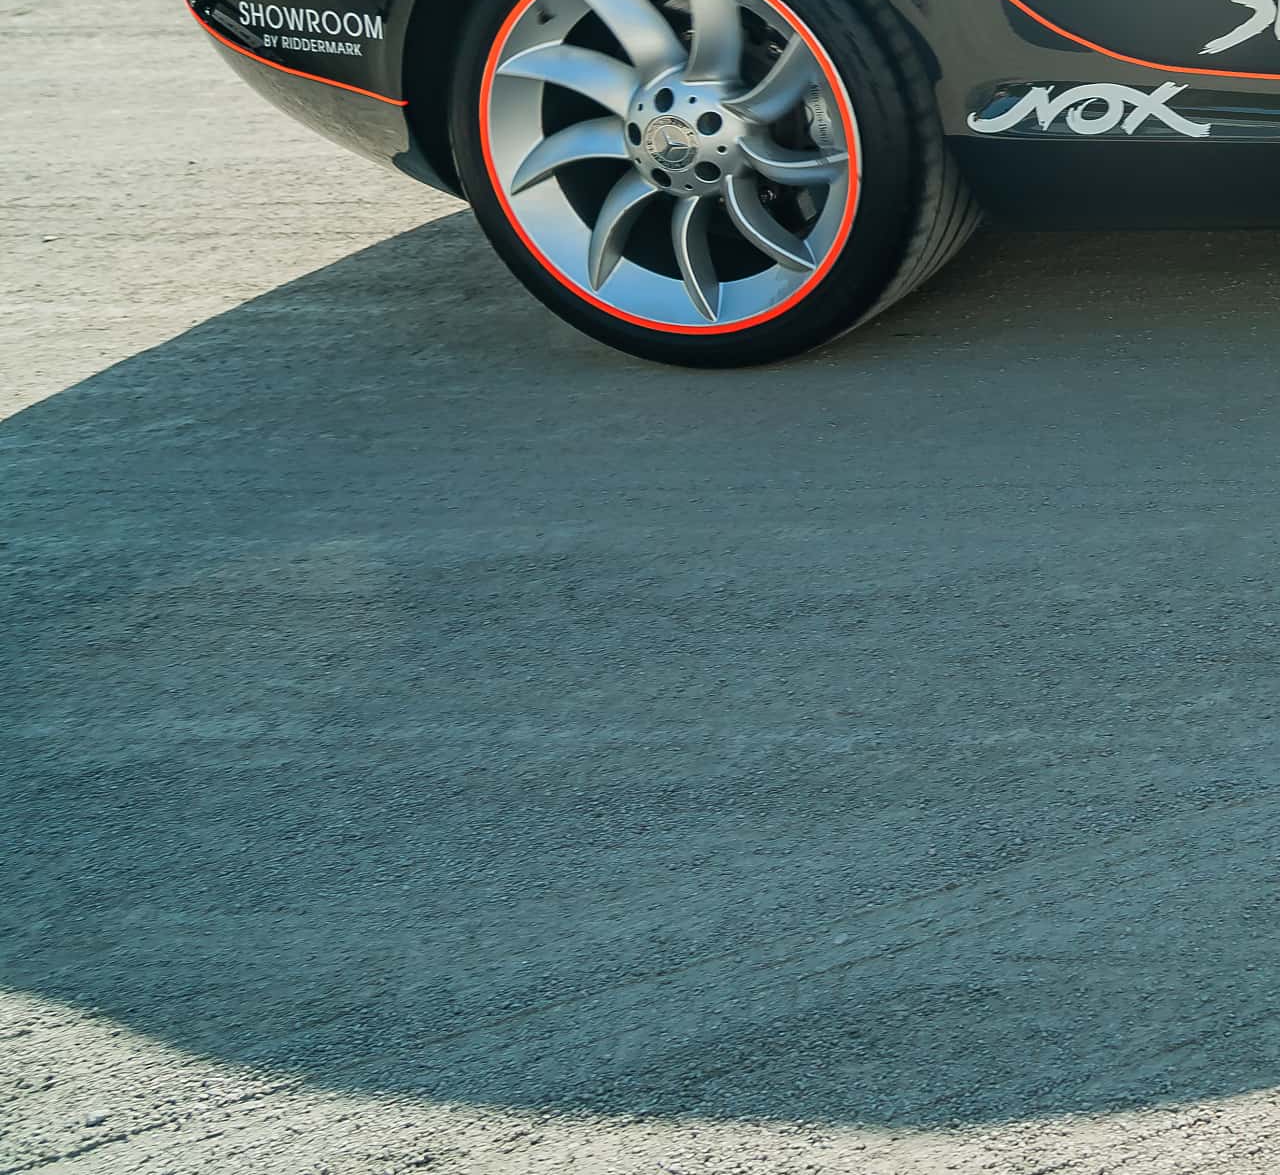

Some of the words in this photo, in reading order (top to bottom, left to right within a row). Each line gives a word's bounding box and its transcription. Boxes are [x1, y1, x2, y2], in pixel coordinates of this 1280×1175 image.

[238, 0, 384, 40] SHOWROOM
[263, 33, 279, 48] BY
[281, 35, 364, 57] RIDDERMARK
[967, 81, 1212, 138] NOX
